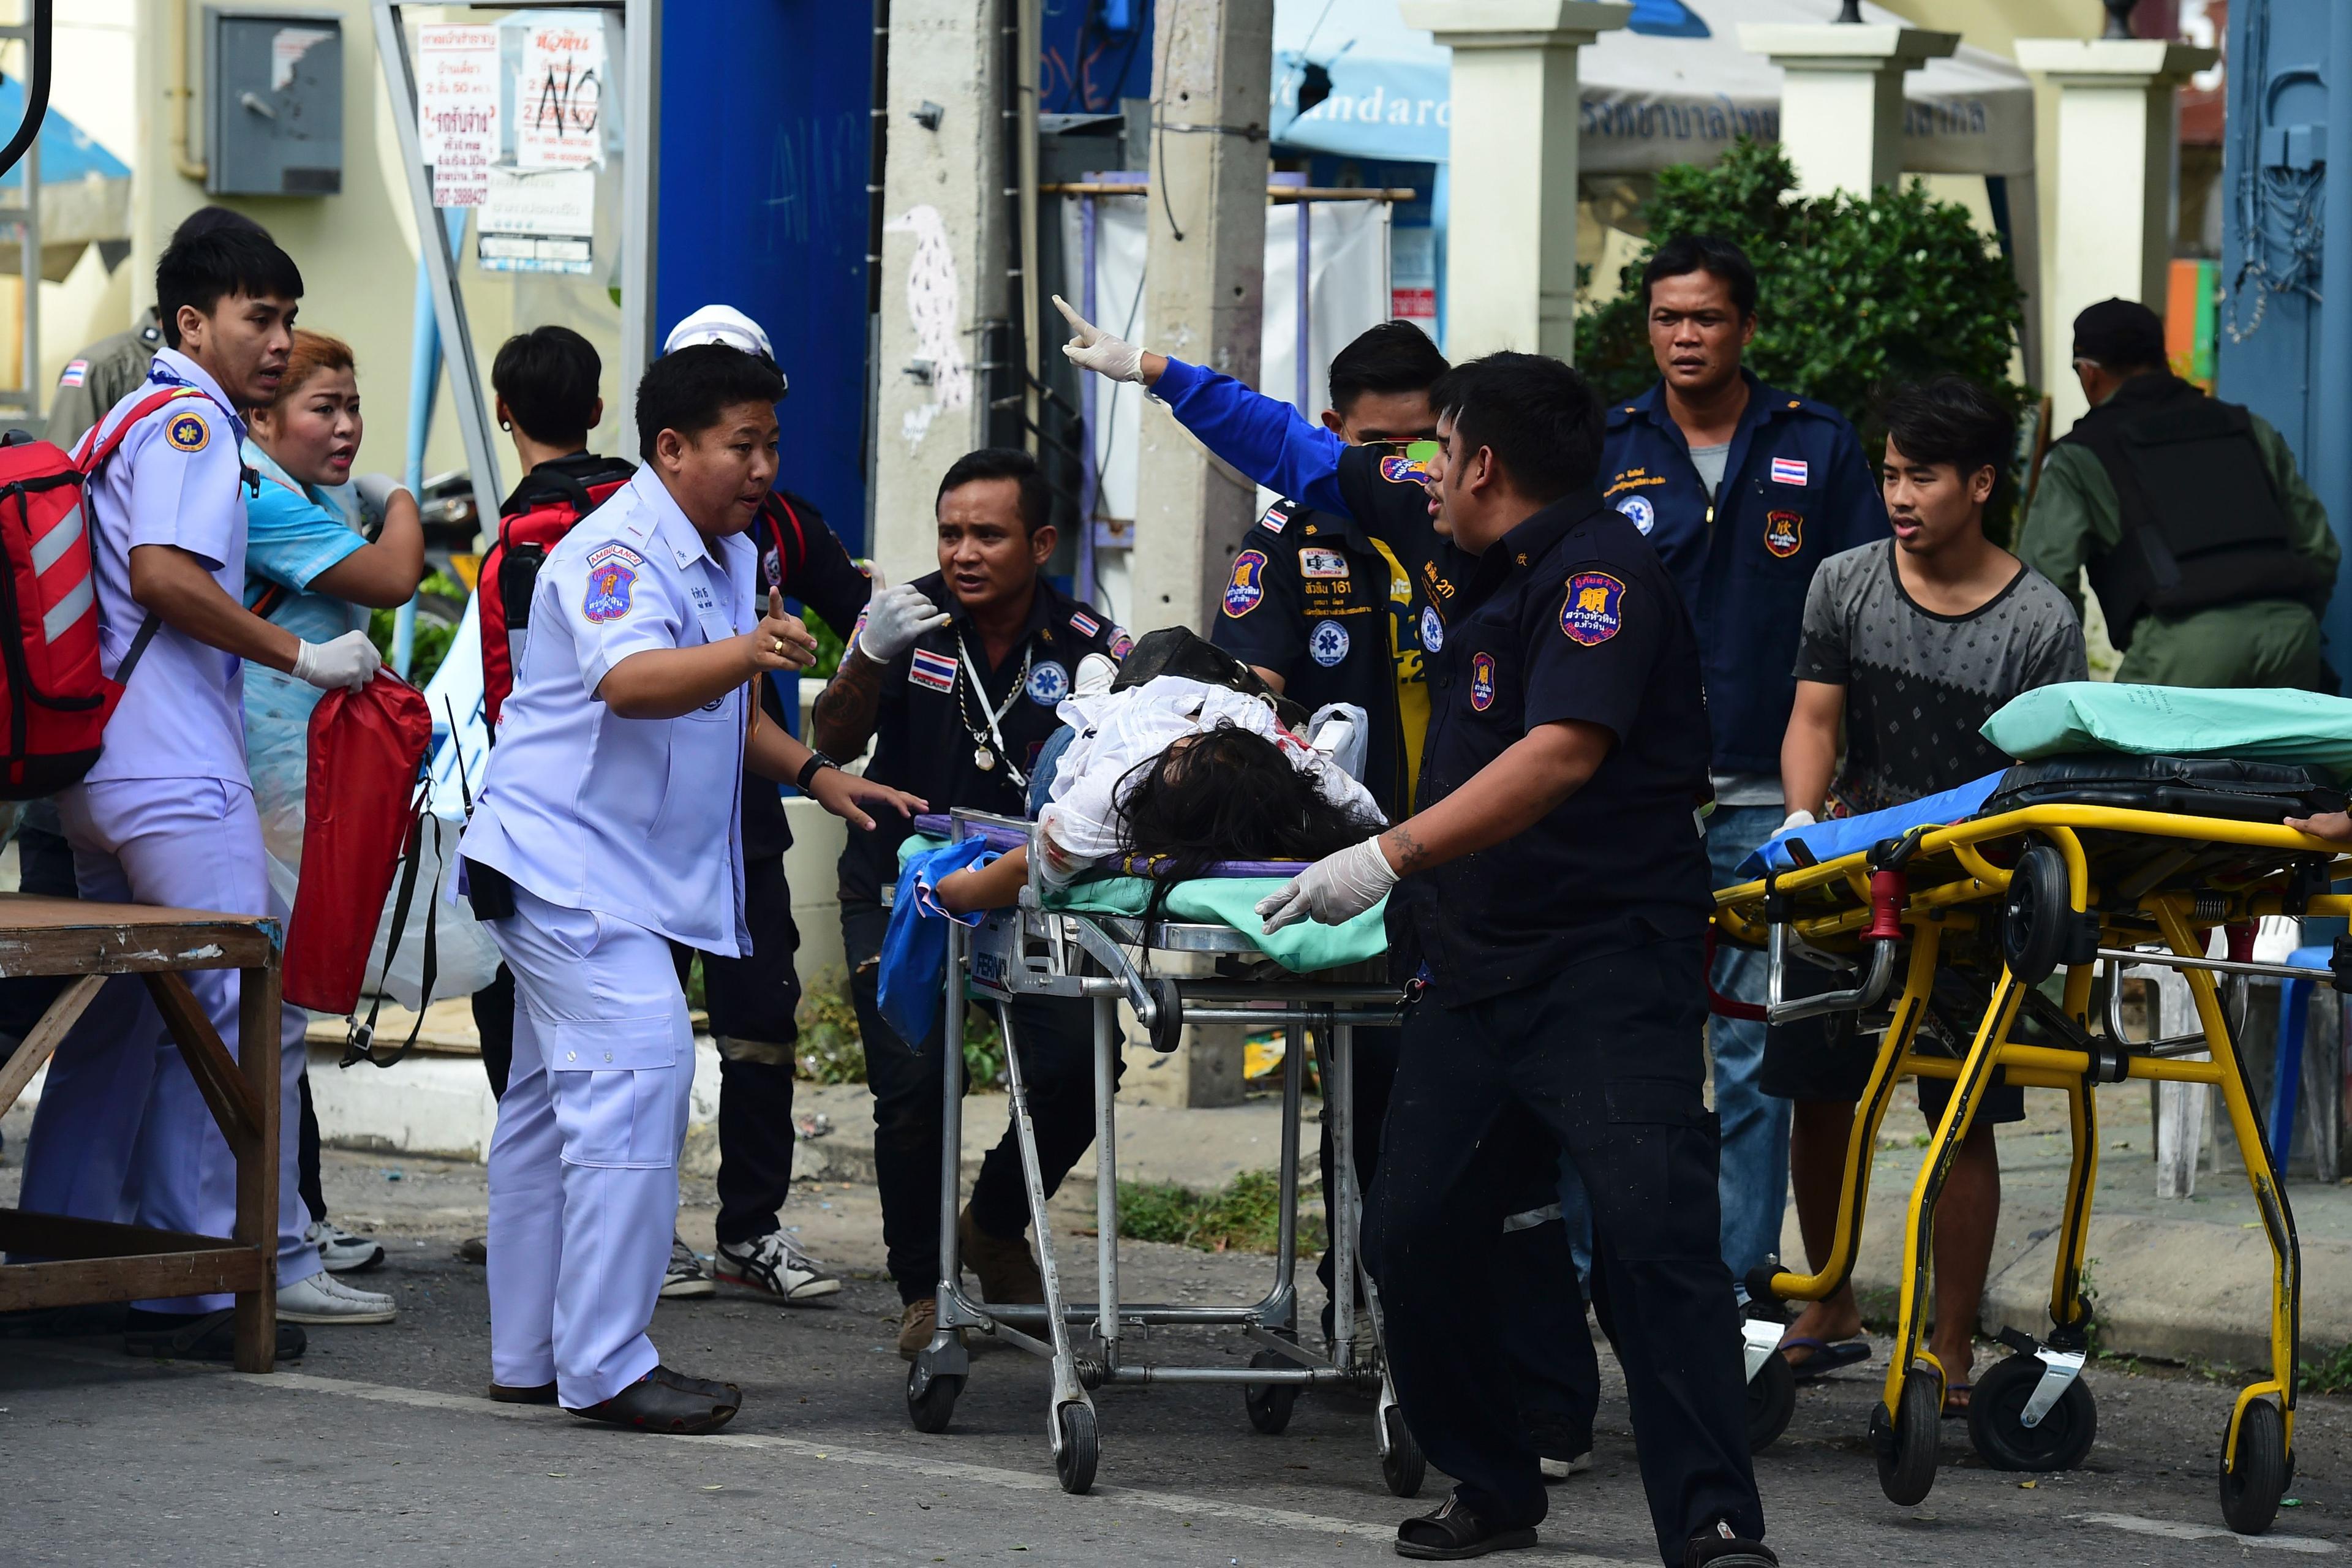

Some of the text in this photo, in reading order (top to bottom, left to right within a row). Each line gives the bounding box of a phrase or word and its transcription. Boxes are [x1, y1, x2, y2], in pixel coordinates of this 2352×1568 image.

[537, 56, 601, 137] NO
[591, 546, 641, 565] AMBULANCE
[1331, 580, 1352, 594] 161
[1436, 579, 1455, 598] 217
[1566, 609, 1616, 625] สว่างหัวหิน
[1574, 620, 1605, 631] อ.หัวหิน
[1564, 622, 1602, 643] RESCUE
